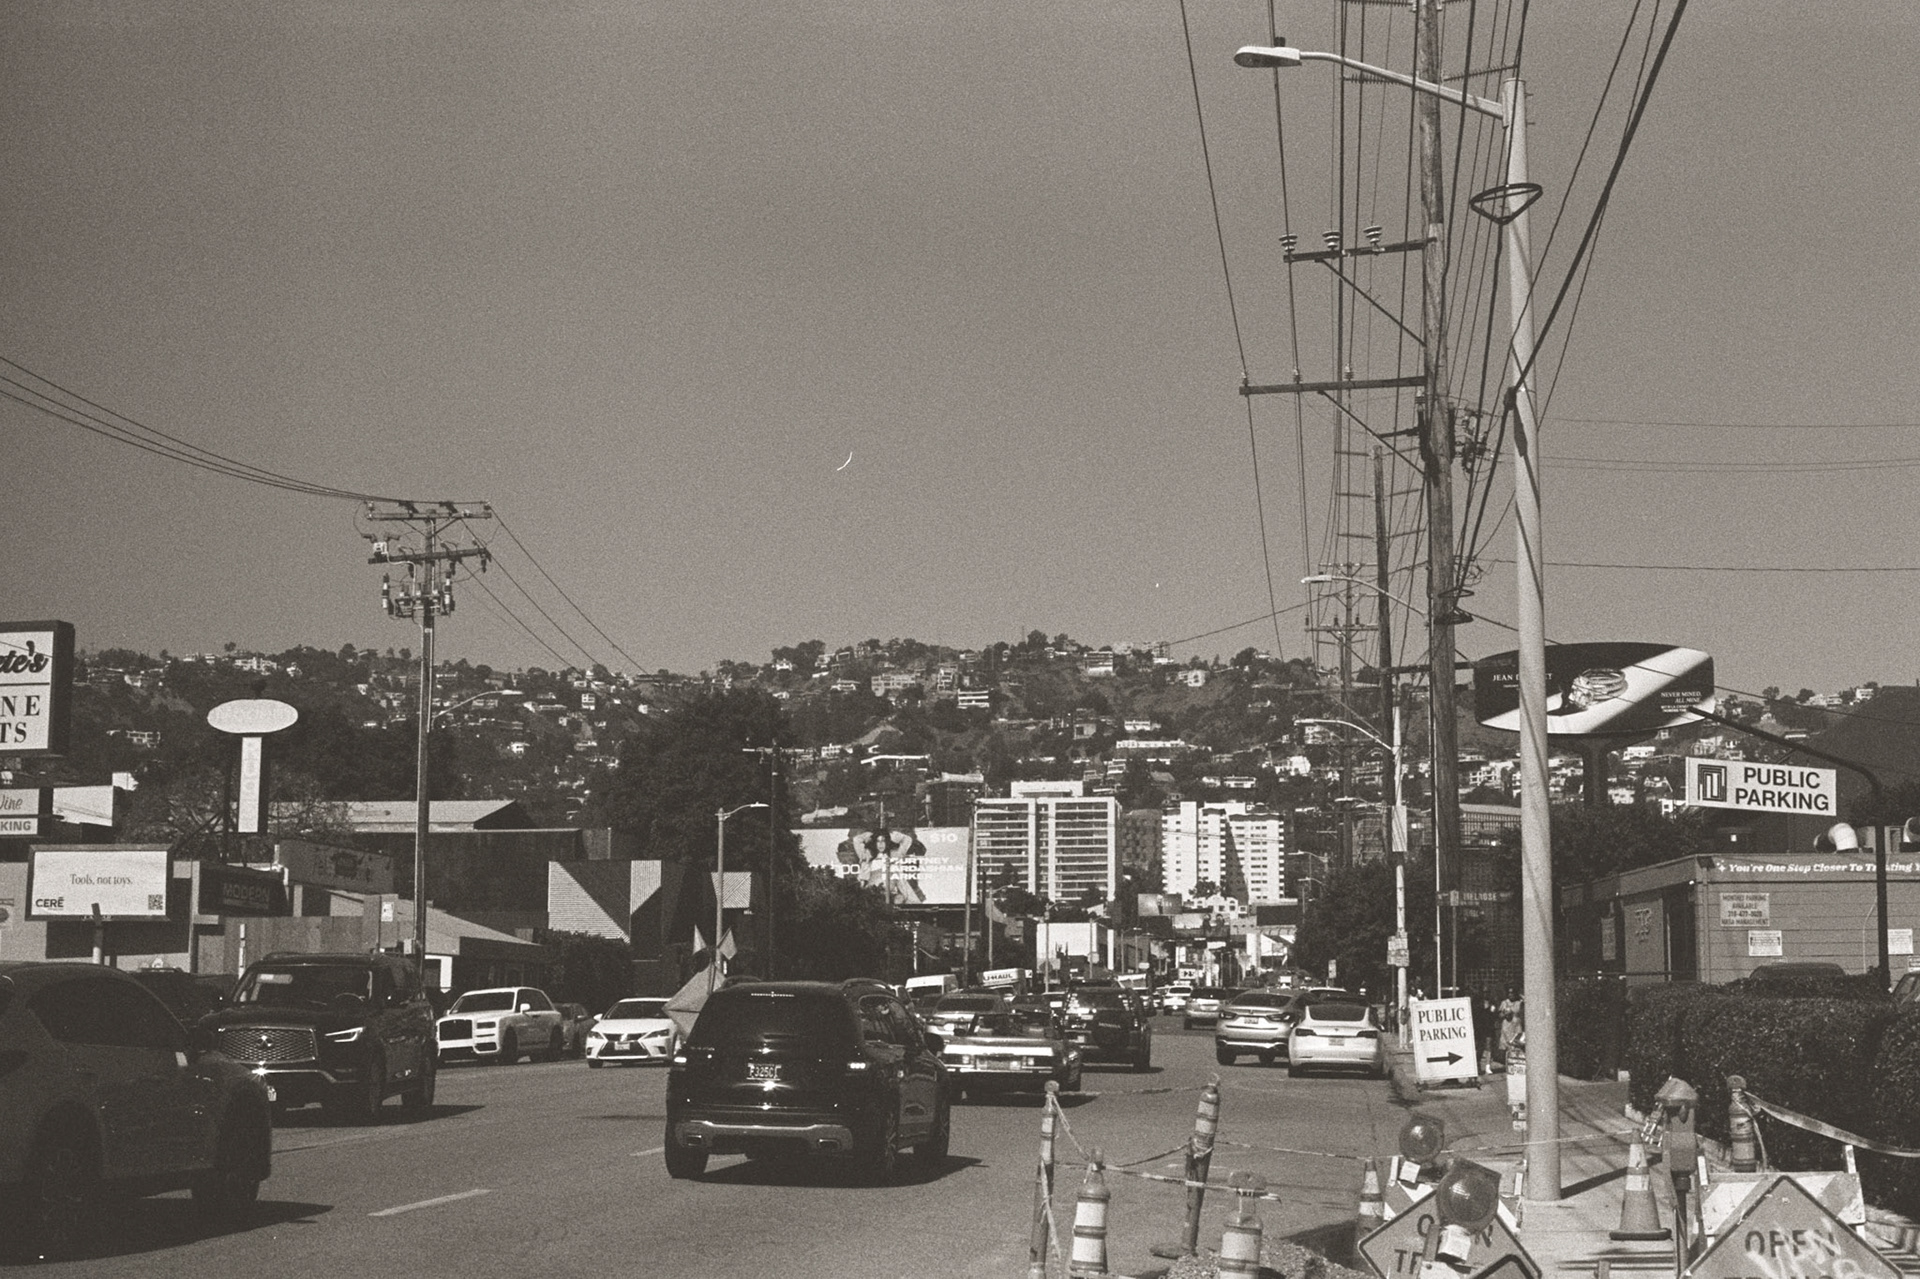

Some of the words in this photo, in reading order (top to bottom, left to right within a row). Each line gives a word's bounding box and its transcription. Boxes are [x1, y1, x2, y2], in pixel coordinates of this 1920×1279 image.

[0, 640, 49, 674] te's
[1743, 766, 1821, 790] PUBLIC
[1734, 787, 1830, 812] PARKING
[1728, 863, 1764, 873] You're
[1765, 863, 1787, 872] One
[1812, 861, 1848, 873] Closer
[1848, 862, 1864, 872] To
[69, 873, 96, 885] Tools,
[97, 875, 112, 885] not
[113, 876, 133, 887] toys.
[1418, 1007, 1465, 1023] PUBLIC
[1420, 1026, 1467, 1041] PARKING
[1744, 1229, 1836, 1258] OPEN
